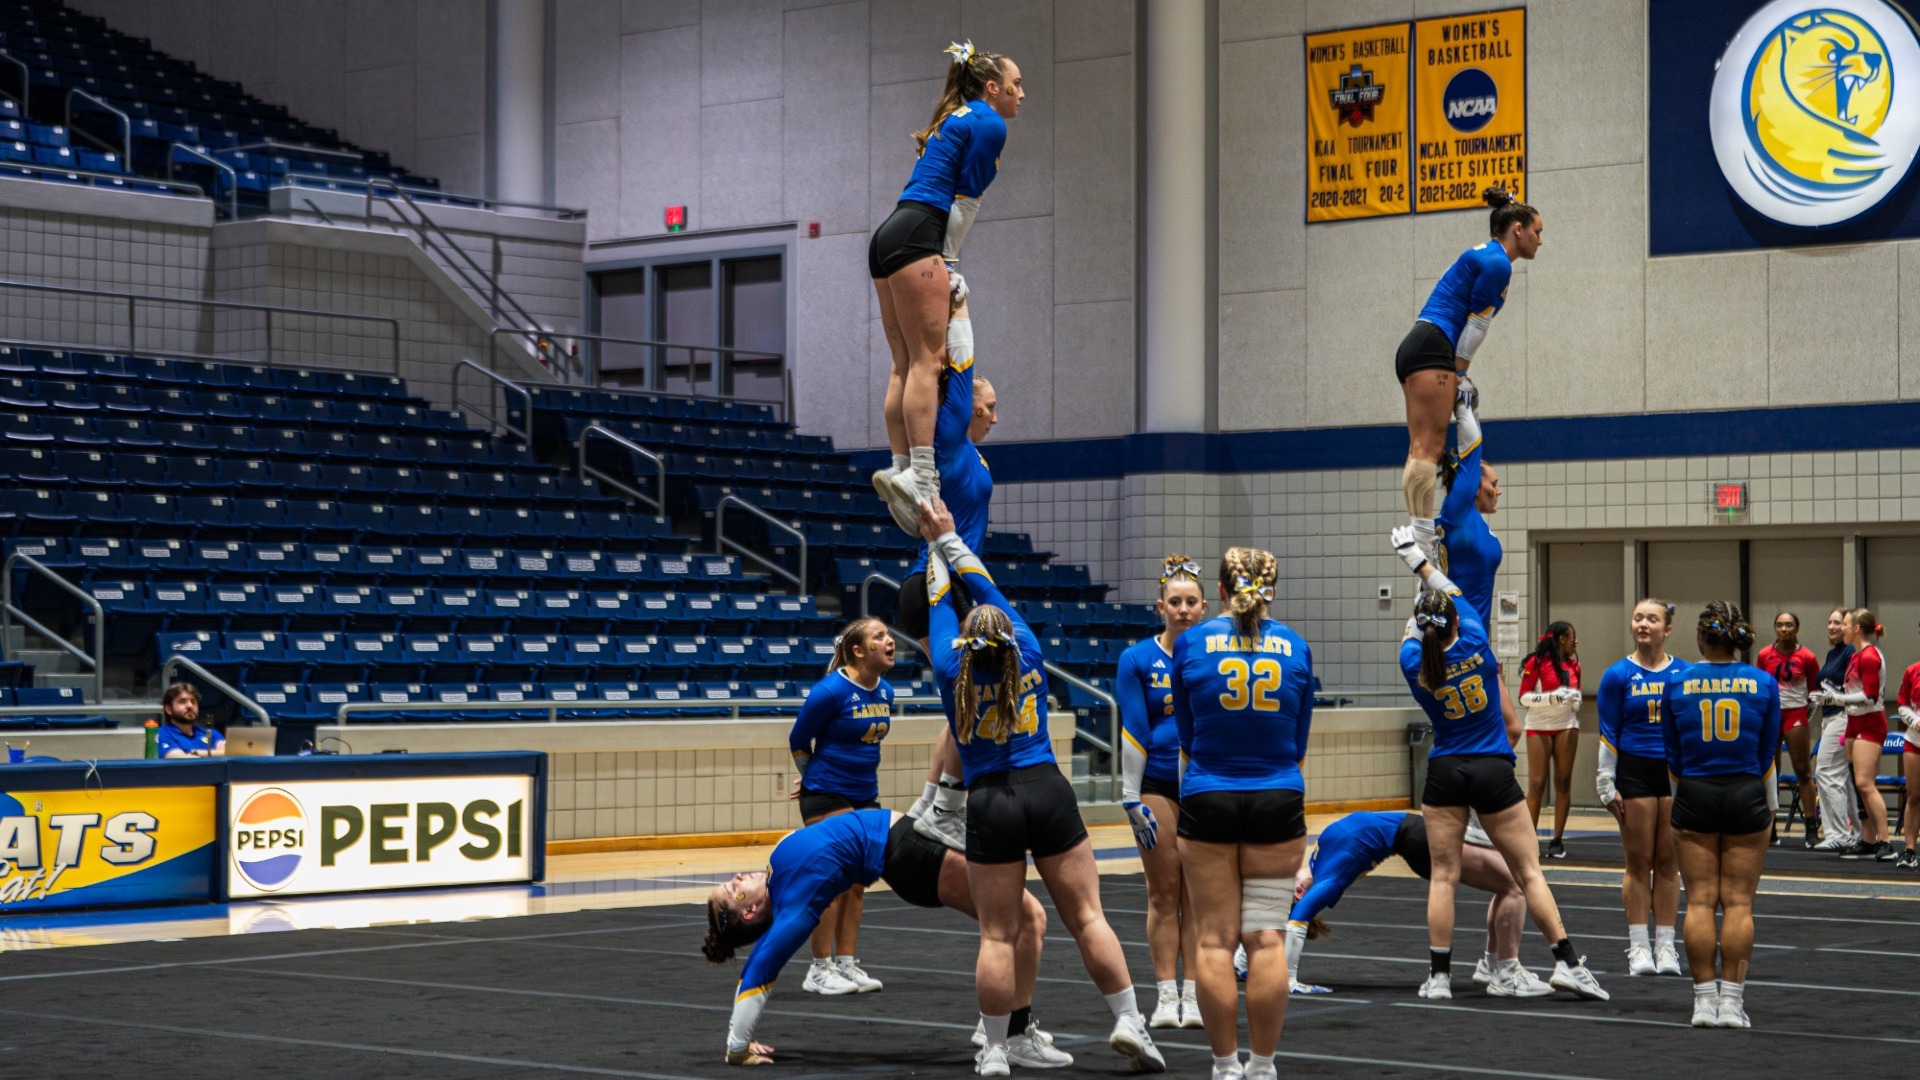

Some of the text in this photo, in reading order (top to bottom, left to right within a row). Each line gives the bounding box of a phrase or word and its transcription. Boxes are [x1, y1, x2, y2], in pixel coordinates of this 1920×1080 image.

[1442, 19, 1500, 43] WOMEN'S
[1310, 36, 1406, 64] WOMEN'S BASKETBALL
[1428, 39, 1512, 66] BASKETBALL
[1335, 91, 1379, 105] FINAL FOUR
[1447, 96, 1497, 119] NCAA
[1347, 132, 1403, 155] TOURNAMENT
[1420, 134, 1523, 160] NCAA TOURNAMENT
[1319, 159, 1398, 183] FINAL FOUR
[1420, 155, 1524, 182] SWEET SIXTEEN
[1311, 184, 1405, 208] 2020-2021 20-2
[1420, 182, 1477, 204] 2021-2022
[1717, 484, 1741, 507] EXIT
[1205, 634, 1292, 657] BEARCATS
[1775, 661, 1796, 682] 15
[1218, 657, 1282, 712] 32
[1434, 674, 1488, 719] 38
[1683, 678, 1757, 695] BEARCATS
[1700, 698, 1741, 742] 10
[237, 828, 304, 850] PEPSI
[321, 798, 523, 867] PEPSI
